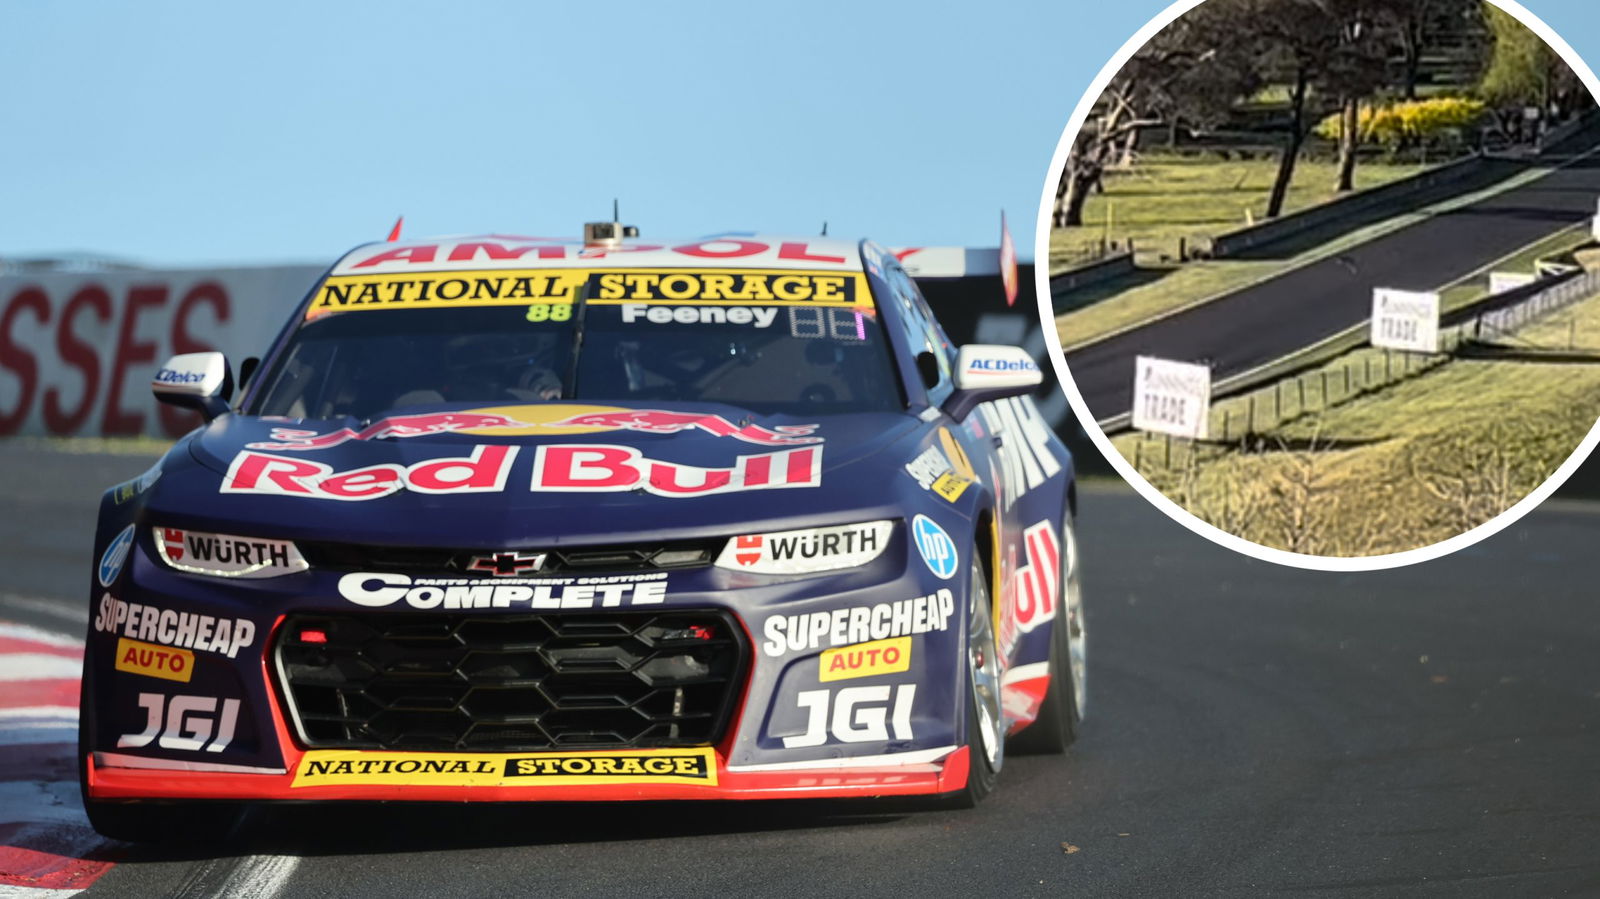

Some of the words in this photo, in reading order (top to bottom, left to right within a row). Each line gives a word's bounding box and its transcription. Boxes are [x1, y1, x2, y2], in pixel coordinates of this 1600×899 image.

[320, 277, 568, 307] NATIONAL
[600, 274, 845, 302] STORAGE
[526, 304, 573, 322] 88
[622, 304, 778, 327] Feeney
[220, 445, 520, 500] Red
[531, 444, 823, 498] Bull
[915, 518, 950, 577] hp
[338, 572, 668, 609] COMPLETE
[577, 572, 668, 585] SOLUTIONS
[94, 591, 256, 659] SUPERCHEAP
[763, 588, 954, 658] SUPERCHEAP
[123, 647, 185, 673] AUTO
[829, 646, 900, 672] AUTO
[117, 692, 241, 753] JGI
[782, 684, 917, 748] JGI
[304, 760, 495, 777] NATIONAL
[517, 757, 698, 775] STORAGE
